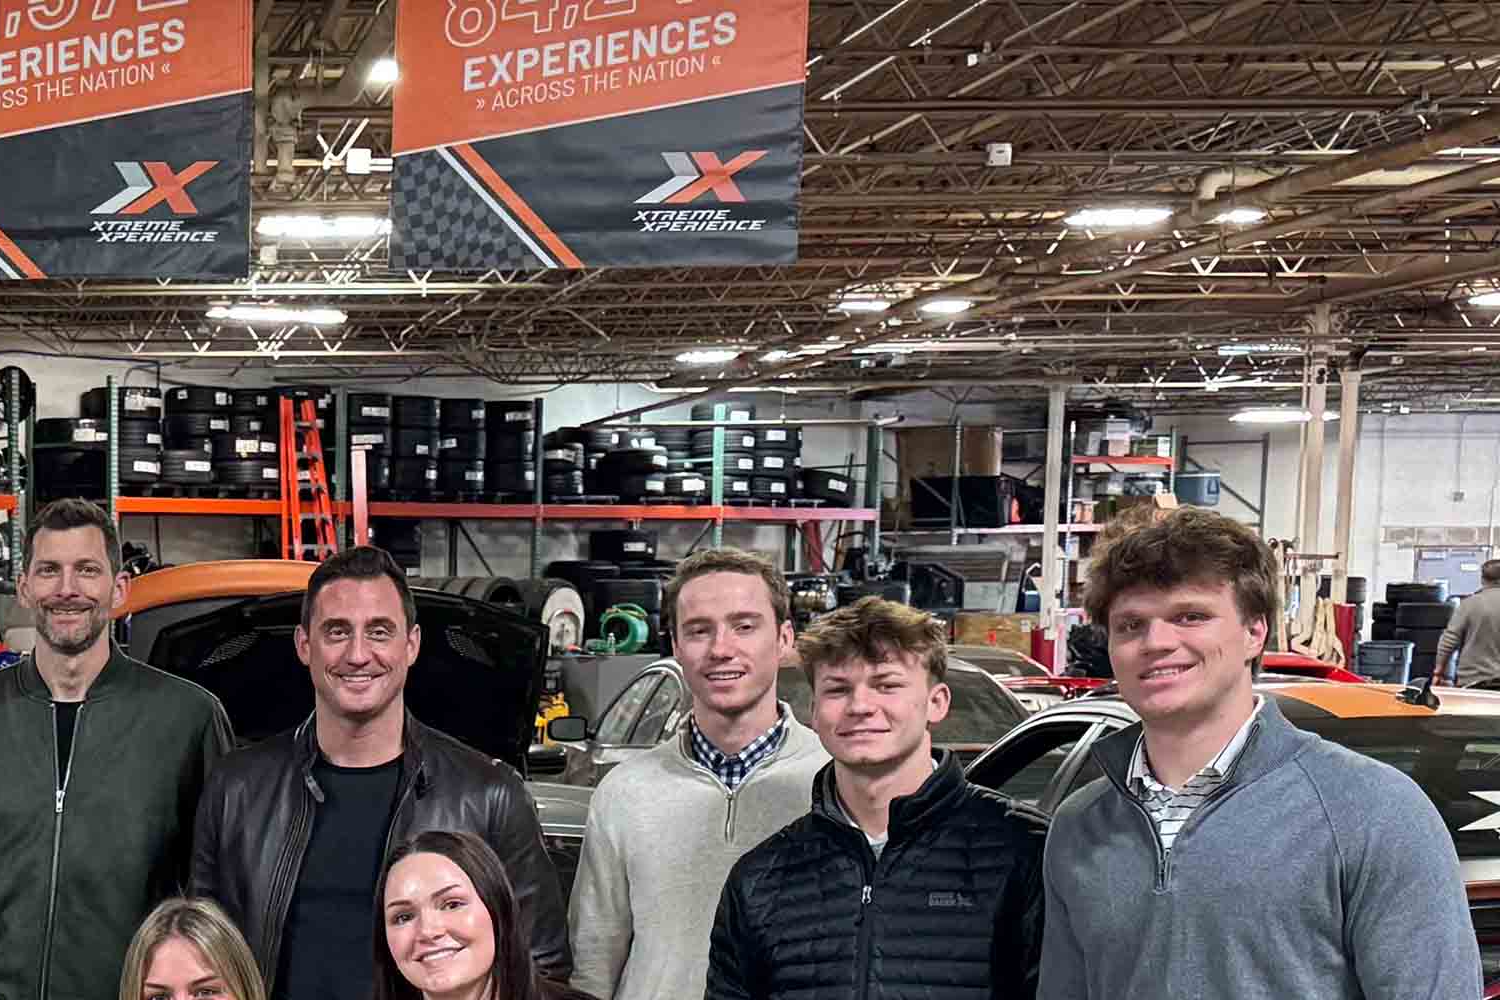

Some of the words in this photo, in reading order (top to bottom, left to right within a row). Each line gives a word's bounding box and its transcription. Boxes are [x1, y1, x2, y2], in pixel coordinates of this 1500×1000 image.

[463, 11, 737, 92] EXPERIENCES
[34, 77, 76, 103] THE
[80, 62, 155, 95] NATION
[491, 79, 575, 112] ACROSS
[581, 70, 621, 94] THE
[628, 54, 705, 87] NATION
[632, 209, 731, 221] XTREME
[90, 220, 185, 232] XTREME
[640, 219, 767, 232] XPERIENCE
[96, 231, 220, 242] XPERIENCE
